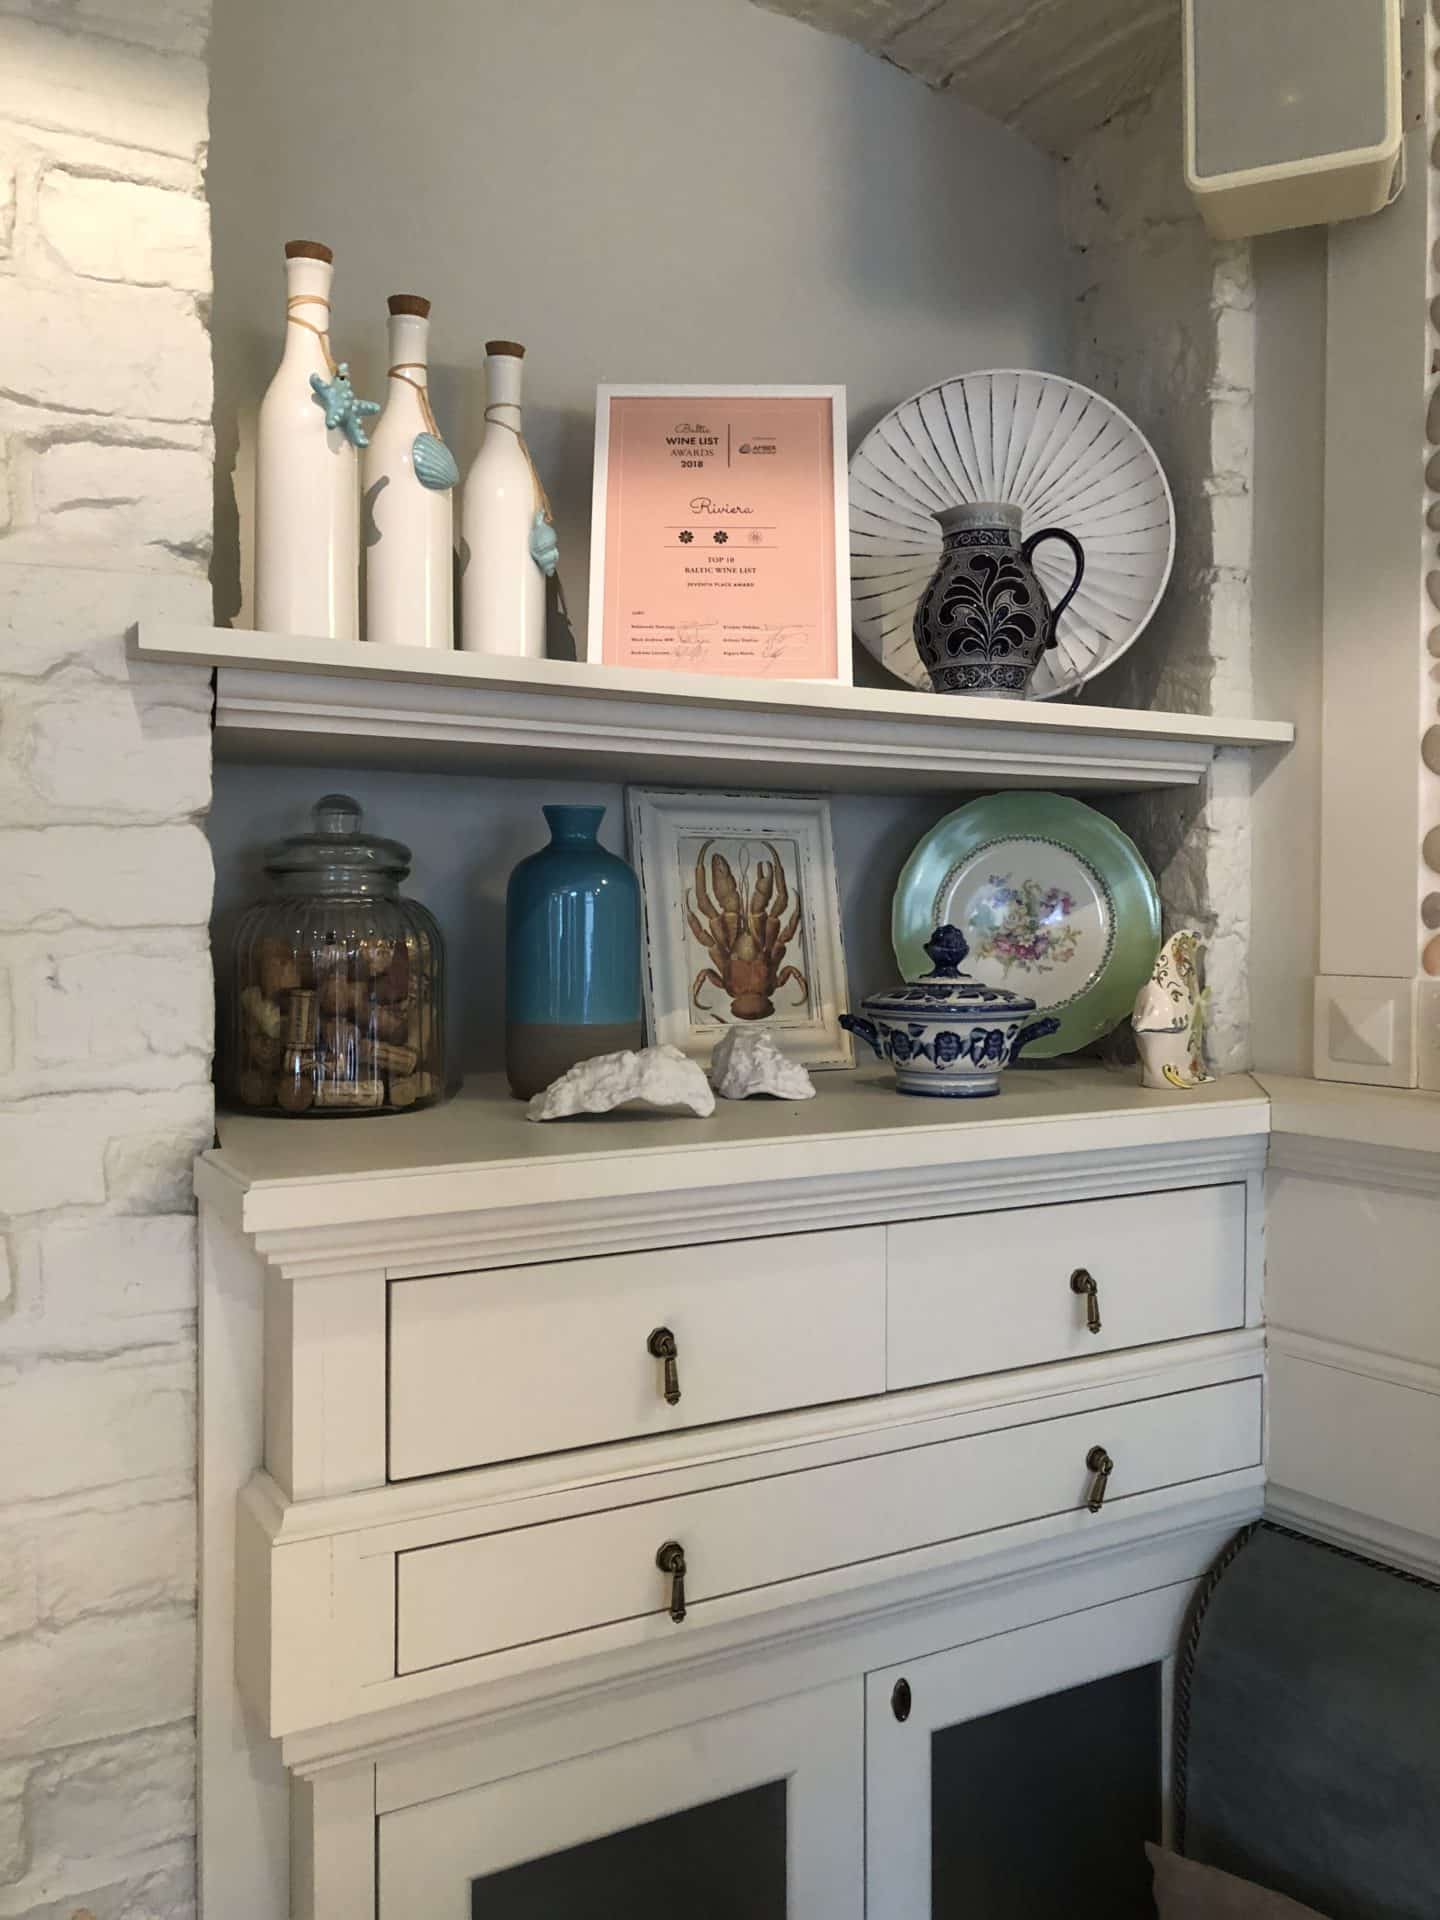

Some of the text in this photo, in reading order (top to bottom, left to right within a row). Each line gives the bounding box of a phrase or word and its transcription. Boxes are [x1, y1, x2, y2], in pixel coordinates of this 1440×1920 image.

[665, 437, 720, 446] WINE LIST
[670, 448, 714, 457] AWARDS
[680, 460, 704, 469] 2018
[689, 497, 754, 514] Riviera
